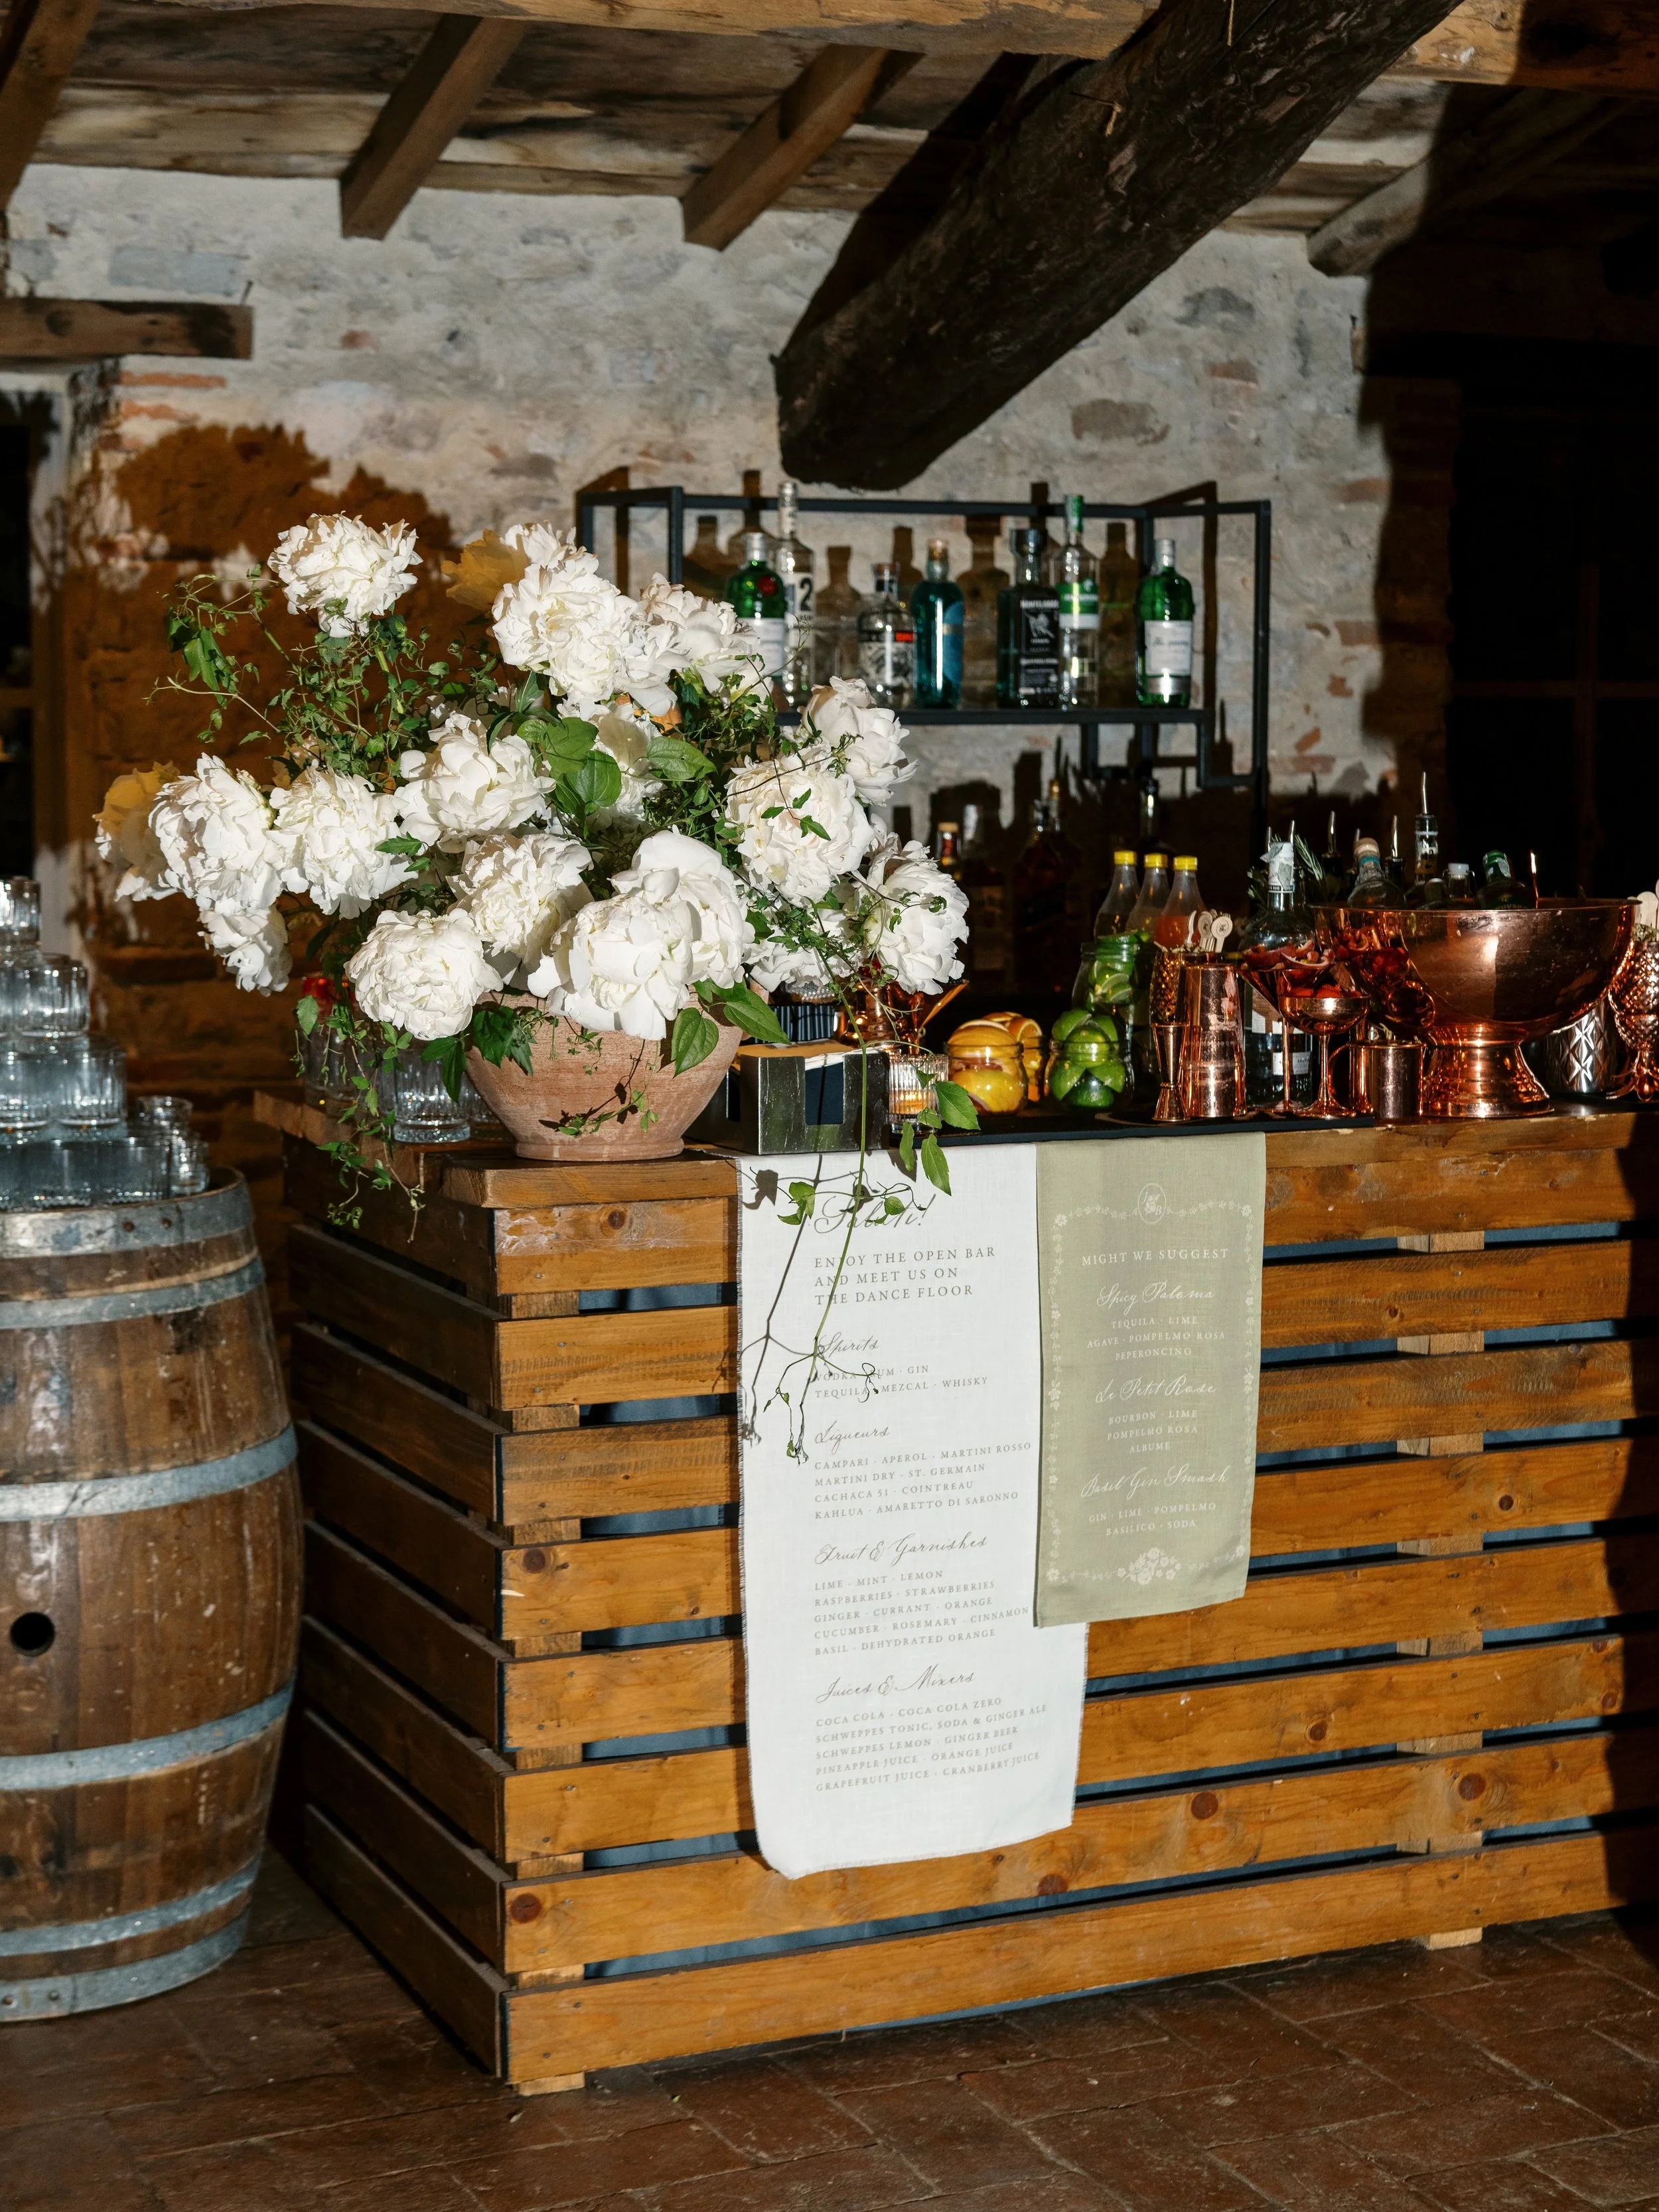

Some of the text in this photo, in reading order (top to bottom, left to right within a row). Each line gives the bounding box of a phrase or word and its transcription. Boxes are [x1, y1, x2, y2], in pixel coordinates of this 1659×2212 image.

[815, 1247, 995, 1268] ENOY THE OPEN BAR
[1082, 1249, 1229, 1266] MIGHT WE SUGGEST
[815, 1268, 958, 1286] AND MEET US ON
[815, 1286, 973, 1305] THE DANCE FLOOR
[1096, 1280, 1214, 1315] Spicy Paloma
[1112, 1317, 1155, 1329] TEQUILA
[817, 1332, 879, 1358] Spirits
[1087, 1331, 1225, 1349] AGAVE POMPELMO ROSA
[1116, 1348, 1192, 1361] PEPERONCINO
[908, 1366, 929, 1374] GIN
[815, 1376, 988, 1398] TEQUILA MEZCAL WHISKY
[1120, 1376, 1165, 1400] Petit
[1109, 1412, 1157, 1424] BOURBON
[815, 1421, 891, 1455] Liqueurs
[1107, 1426, 1197, 1440] POMPELMO ROSA
[815, 1442, 1031, 1470] CAMPARI APEROL MARTINI ROSSO
[1129, 1442, 1171, 1453] ALBUME
[815, 1475, 868, 1486] MARTINI
[873, 1472, 895, 1481] DRY
[930, 1463, 985, 1476] GERMAIN
[1081, 1463, 1230, 1500] Basil Gin Smash
[815, 1491, 873, 1503] CACHACA
[902, 1481, 974, 1494] COINTREAU
[815, 1508, 863, 1519] KAHLUA
[877, 1500, 942, 1513] AMARETTO
[966, 1492, 1019, 1505] SARONNO
[1089, 1503, 1217, 1523] GIN LIME POMPELMO
[1106, 1520, 1196, 1536] BASILICO SODA
[815, 1544, 869, 1564] Fruit
[887, 1532, 988, 1566] Garnishes
[815, 1571, 943, 1590] LIME MINT LEMON
[815, 1581, 995, 1606] RASPBERRIES STRAWBERRIES
[815, 1597, 993, 1623] GINGER CURRANT ORANGE
[815, 1607, 1029, 1639] CUCUMBER ROSEMARY CINNAMON
[815, 1629, 995, 1655] BASIL DEHYDRATED ORANGE
[816, 1678, 874, 1703] Juices
[895, 1664, 975, 1691] Mixers
[816, 1698, 1001, 1726] COCA COLA COCA COLA ZERO
[816, 1727, 885, 1743] SCHWEPPES
[937, 1718, 968, 1729] SODA
[985, 1709, 1025, 1723] GINGER
[1029, 1704, 1047, 1715] ALE
[816, 1726, 1019, 1759] SCHWEPPES LEMON GINGER BEER
[816, 1742, 1014, 1775] PINEAPPLE JUICE ORANGE JUICE
[816, 1752, 1040, 1792] GRAPEFRUIT JUICE CRANBERRY JUICE
